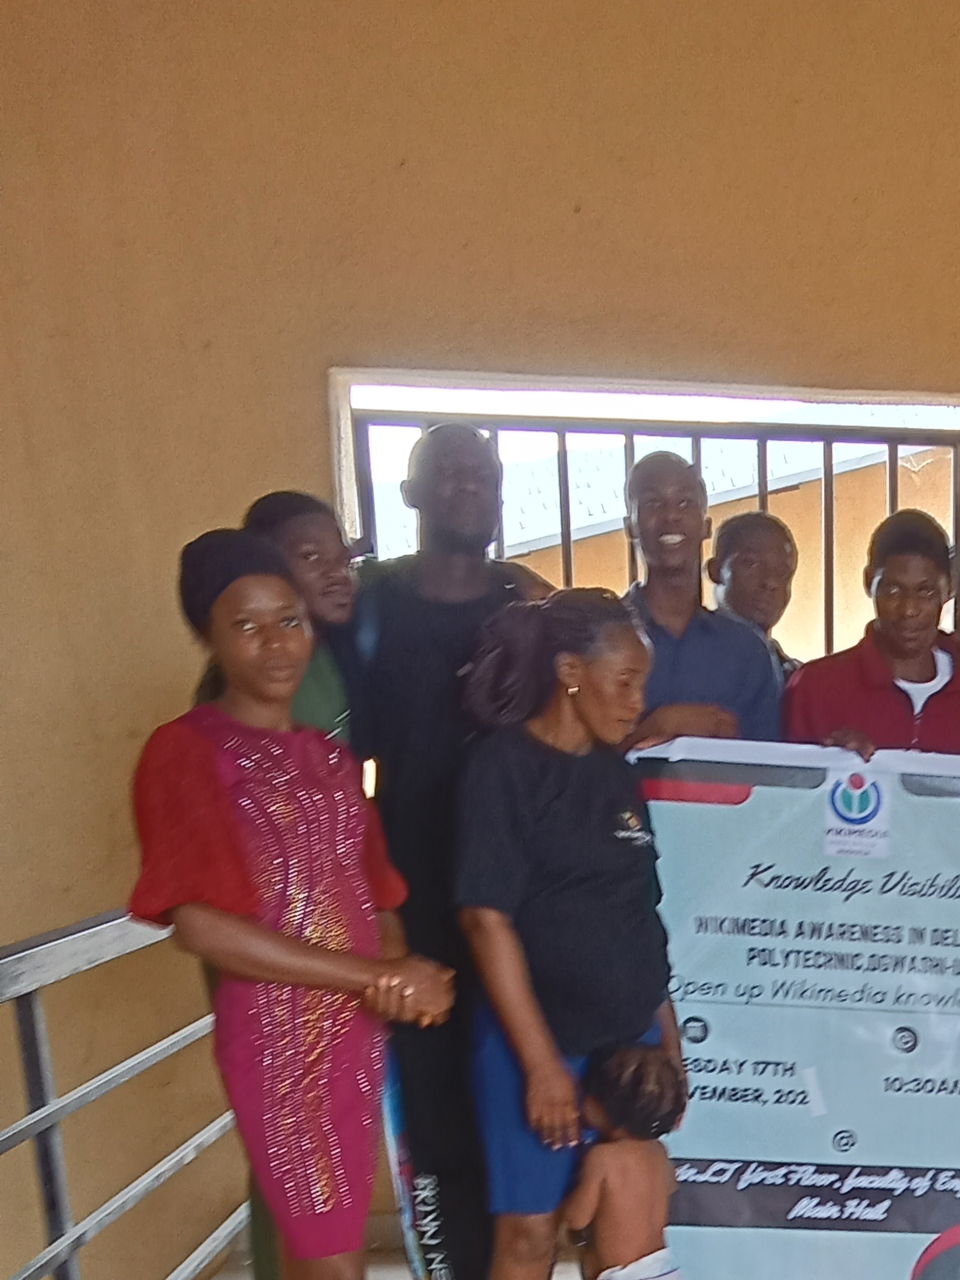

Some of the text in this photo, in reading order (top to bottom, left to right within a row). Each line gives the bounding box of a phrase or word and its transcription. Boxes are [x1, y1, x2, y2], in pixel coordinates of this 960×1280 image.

[742, 863, 873, 903] Knowledge
[694, 916, 787, 938] WIKIMEDIA
[794, 920, 903, 944] AWARENESS
[667, 975, 728, 1002] Open
[734, 983, 765, 1005] up
[771, 979, 888, 1004] Wikimedia
[751, 1060, 797, 1077] 17TH
